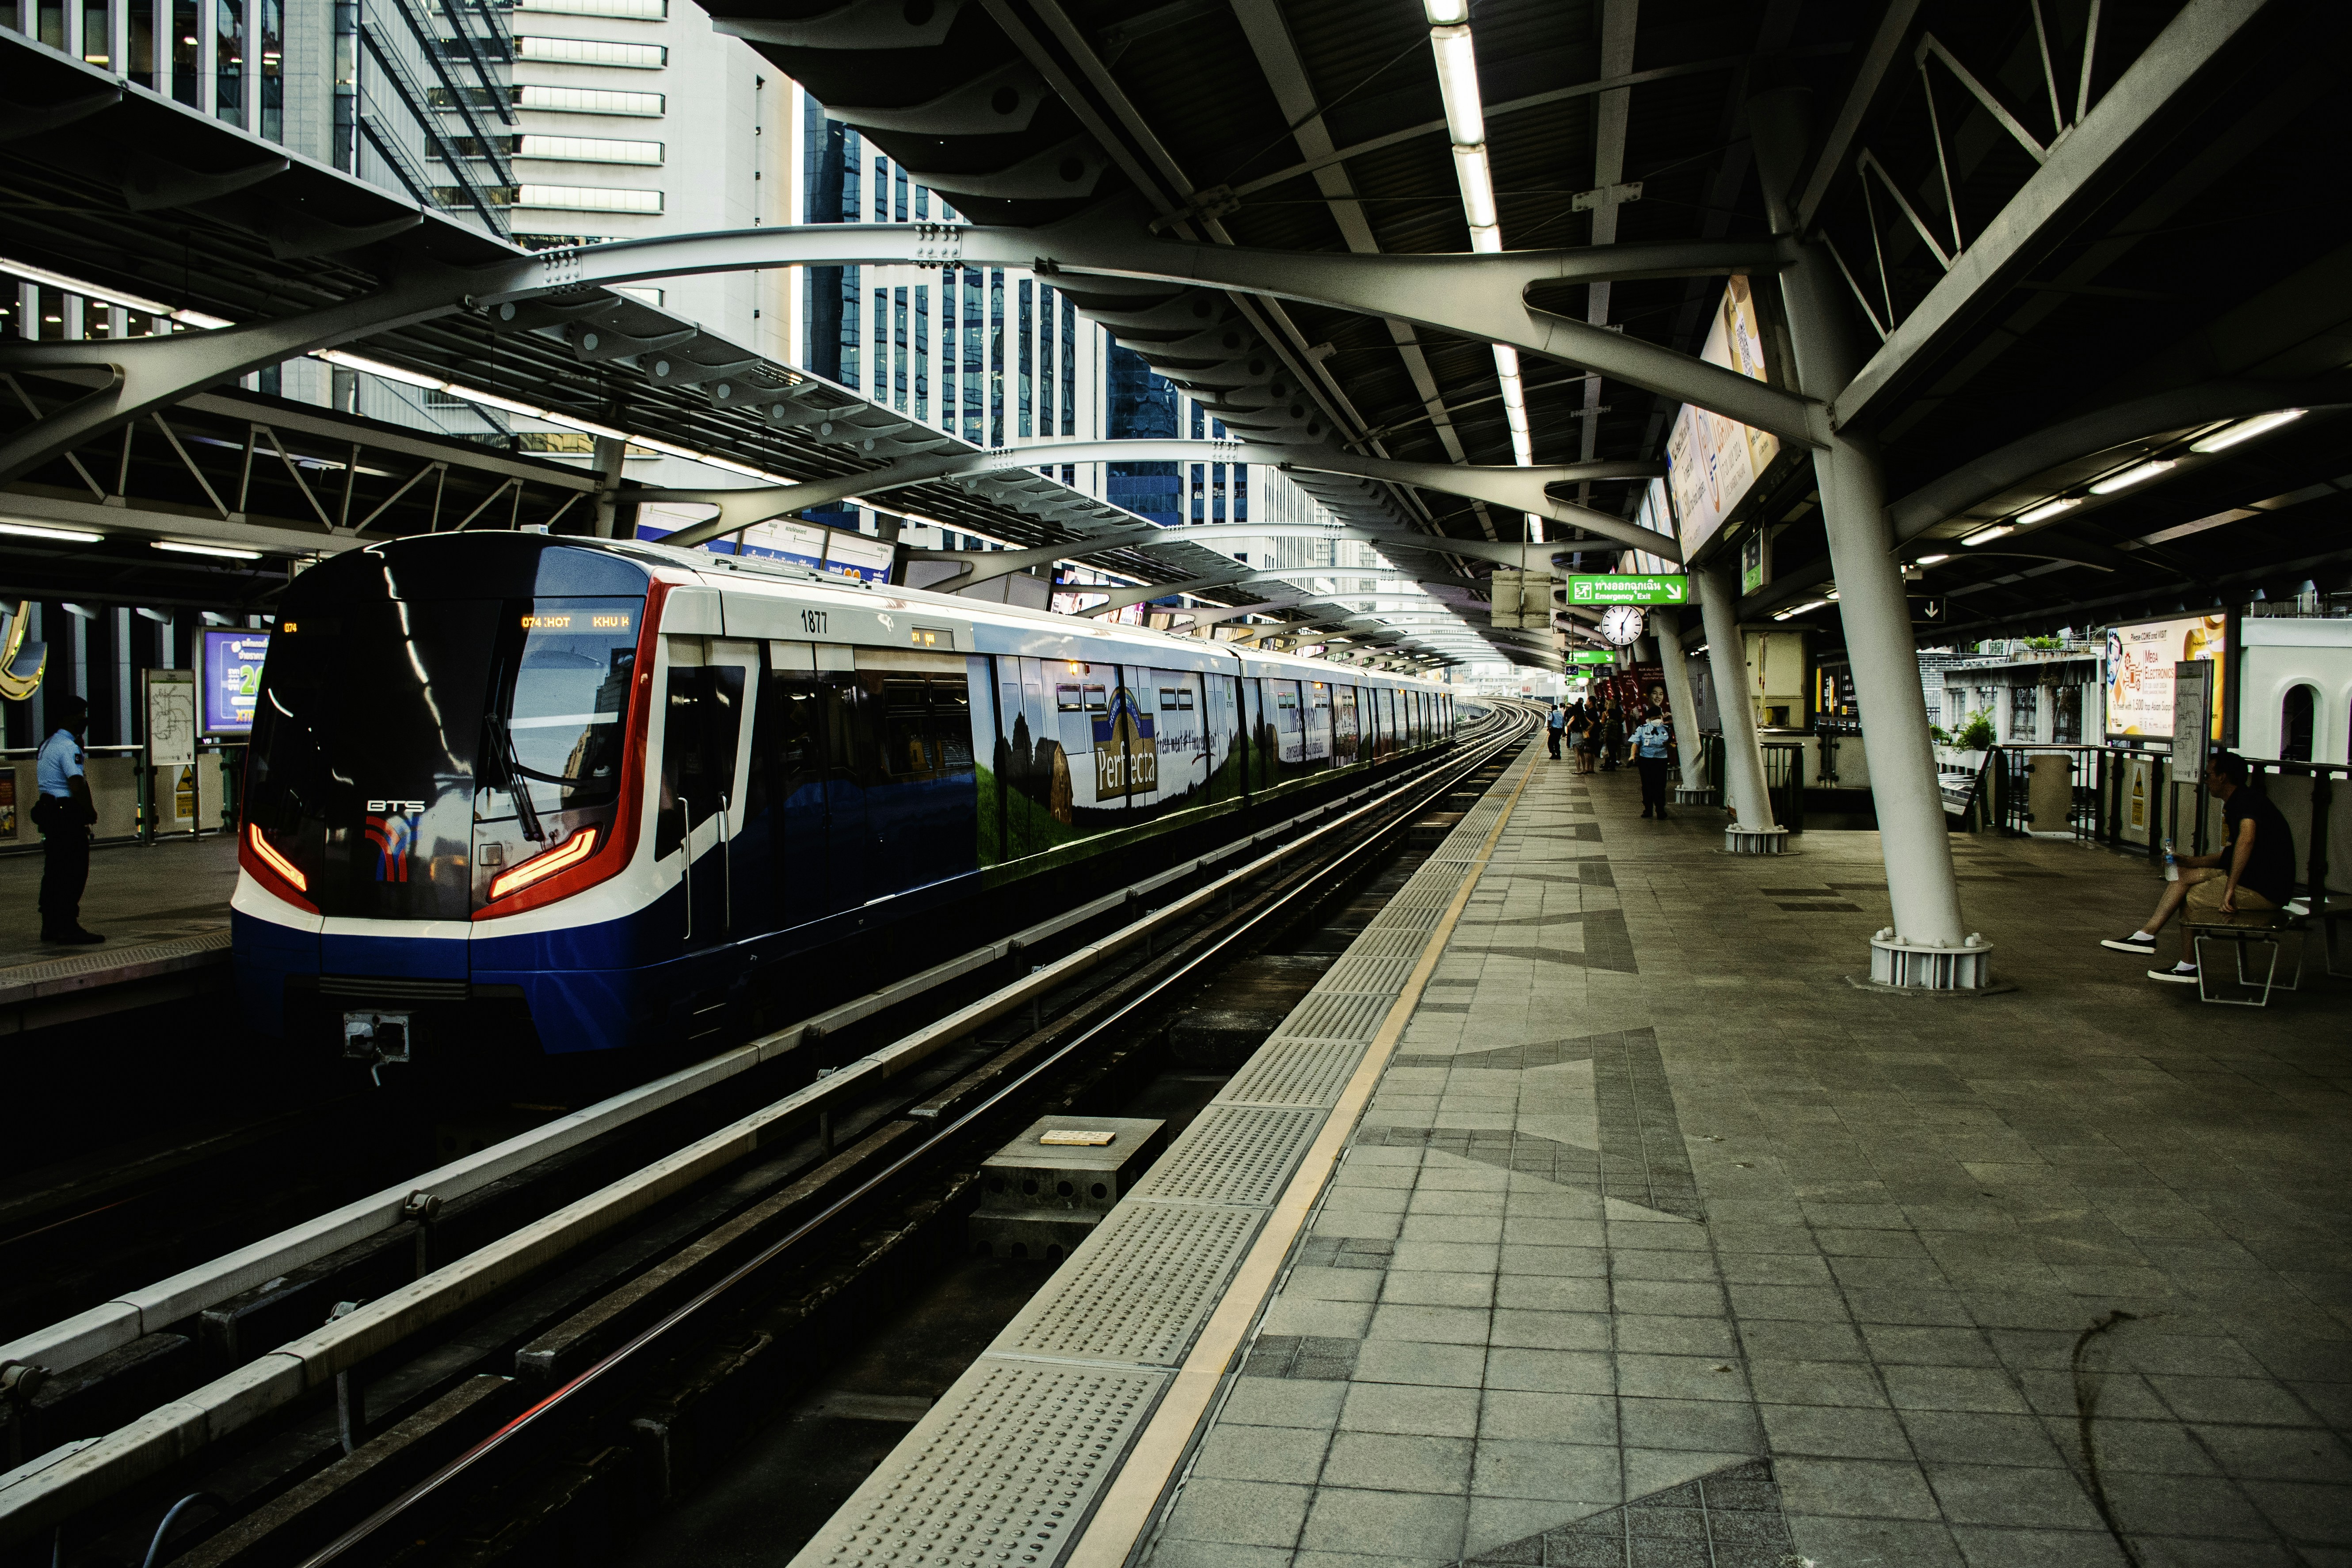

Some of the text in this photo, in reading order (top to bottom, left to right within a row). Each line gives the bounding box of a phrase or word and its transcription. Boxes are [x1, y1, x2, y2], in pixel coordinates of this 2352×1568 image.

[1595, 579, 1661, 594] ทางออกฉุกเฉิน
[284, 623, 297, 633] 074
[522, 617, 542, 628] 074
[593, 617, 618, 627] KHU
[801, 609, 827, 634] 1877
[2141, 631, 2151, 640] COME
[2157, 629, 2167, 638] VISIT
[2145, 649, 2158, 663] MEGA
[2145, 666, 2174, 679] ELECTRONICS
[2133, 699, 2143, 712] 1,500
[2151, 701, 2161, 710] Asian
[1131, 705, 1141, 729] FOOD
[1156, 731, 1170, 755] Fresh
[1171, 730, 1183, 754] meat
[1183, 729, 1191, 752] #1
[1097, 740, 1155, 791] Perfecta
[366, 800, 426, 813] BTS
